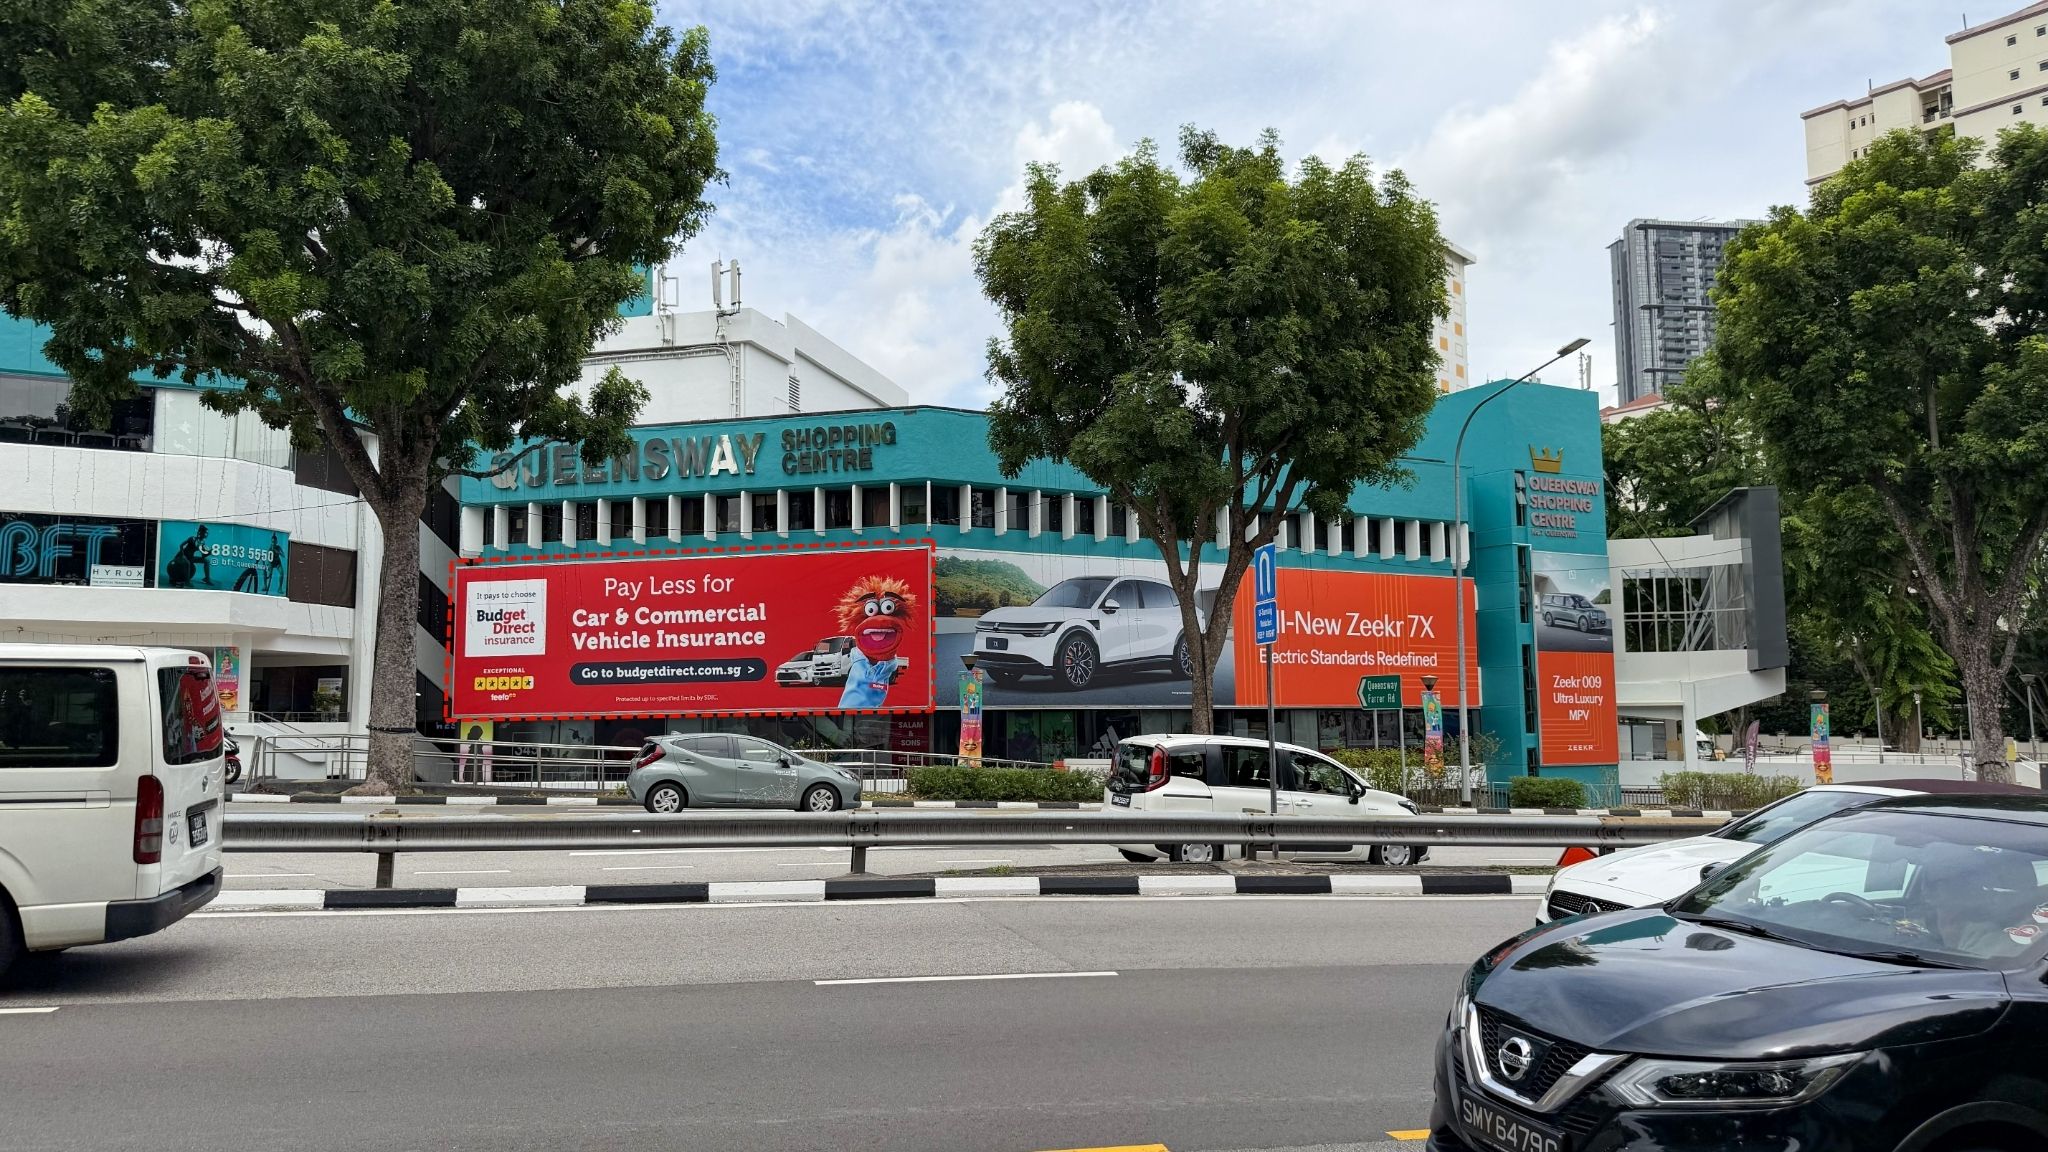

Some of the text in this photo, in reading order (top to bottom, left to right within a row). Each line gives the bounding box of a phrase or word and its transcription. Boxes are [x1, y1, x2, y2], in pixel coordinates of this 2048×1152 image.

[781, 422, 897, 451] SHOPPING
[782, 447, 873, 475] CENTRE
[1529, 476, 1600, 496] QUEENSWAY
[1530, 494, 1593, 513] SHOPPING
[1530, 512, 1576, 529] CENTRE
[0, 521, 120, 578] BFT
[211, 543, 274, 562] 8833 5550
[92, 568, 143, 577] HYROX
[484, 593, 500, 601] pays
[511, 591, 537, 599] choose
[604, 574, 735, 601] Pay Less for
[476, 609, 526, 624] Budget
[572, 603, 766, 627] Car & Commercial
[493, 622, 535, 634] Direct
[1276, 609, 1436, 639] ll-New Zeekr 7X
[484, 636, 535, 646] insurance
[572, 630, 766, 650] Vehicle Insurance
[1259, 648, 1438, 667] Eectric Standards Redefined
[581, 664, 742, 682] Go to budgetdirect.com.sg
[1552, 675, 1602, 688] Zeekr 009
[1367, 681, 1398, 691] Queensway
[1367, 693, 1396, 703] Farrer Rd
[1553, 692, 1604, 706] Ultra Luxury
[1568, 709, 1590, 720] MPV
[898, 721, 924, 729] SALAM
[901, 739, 921, 747] SONS
